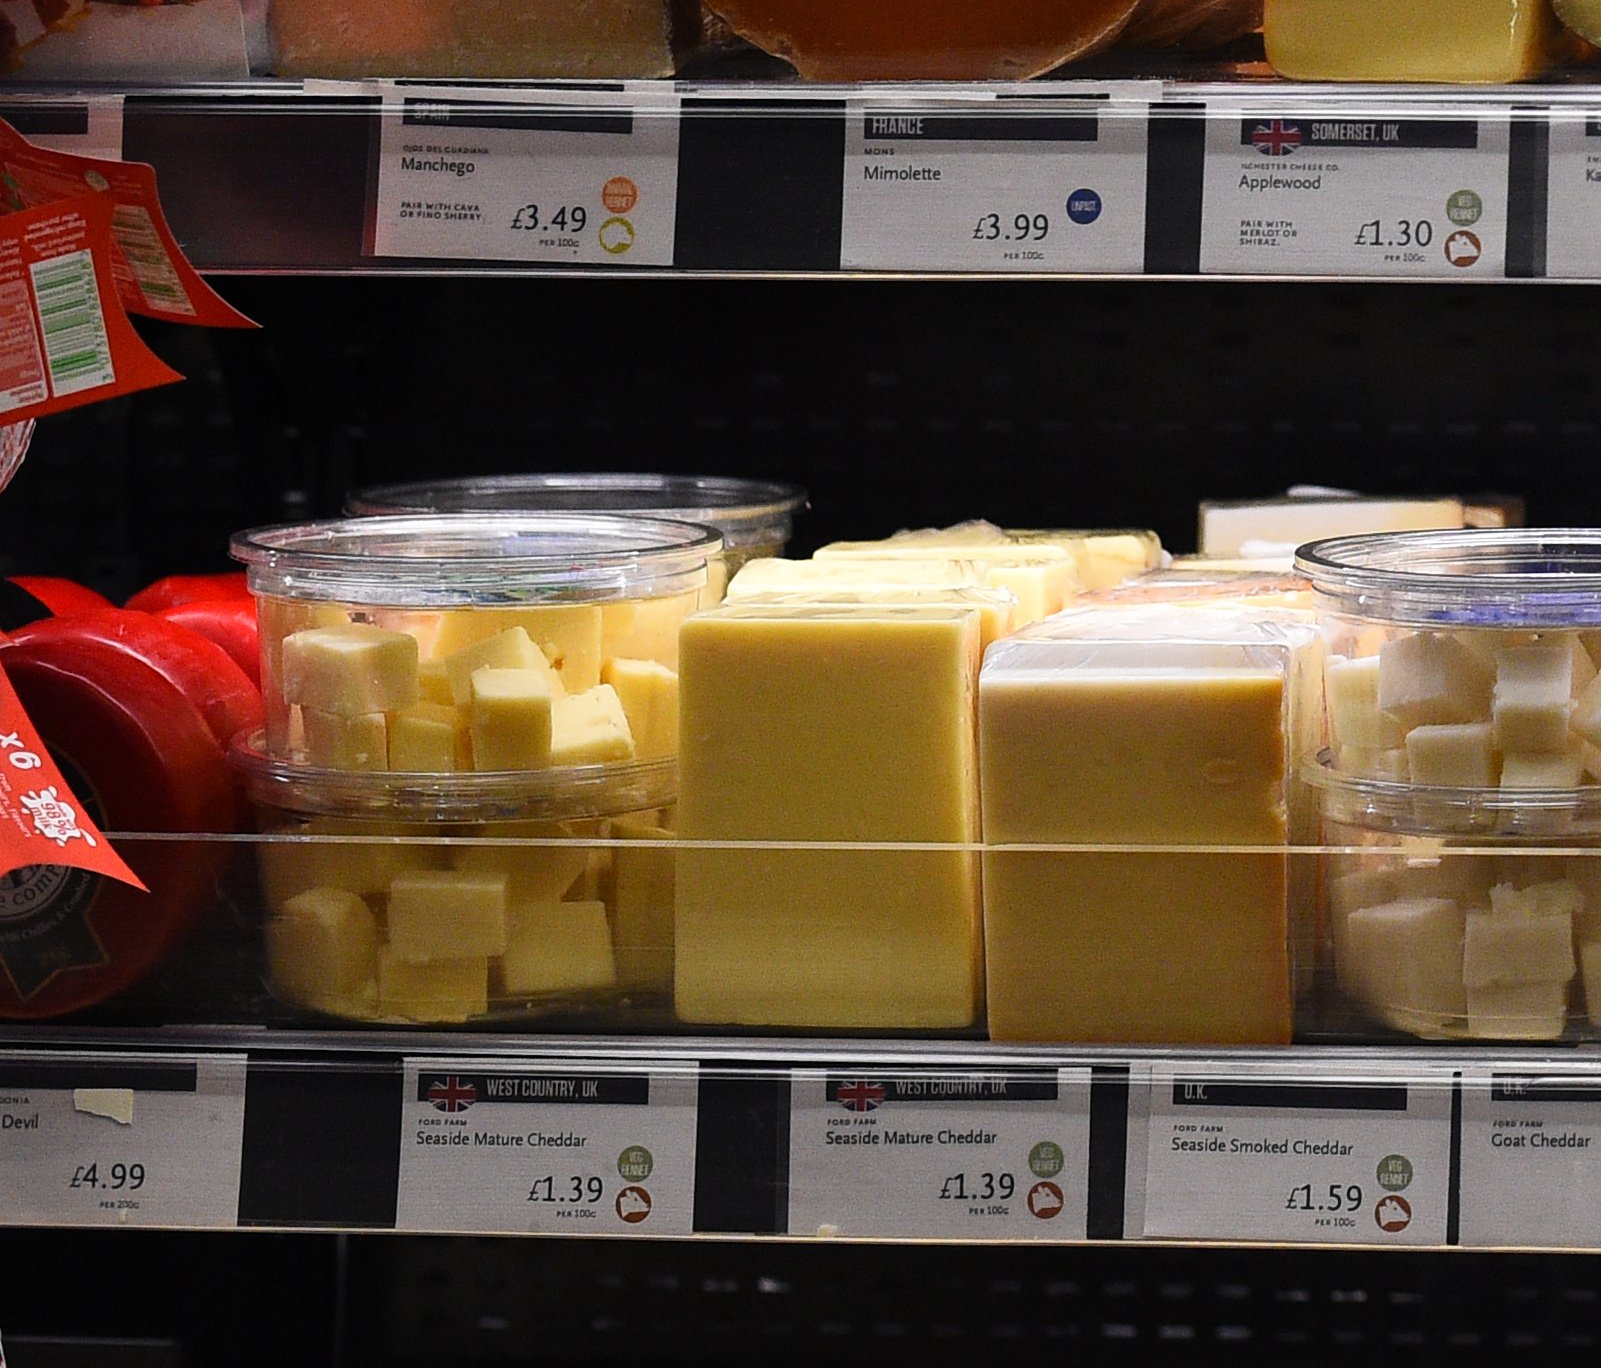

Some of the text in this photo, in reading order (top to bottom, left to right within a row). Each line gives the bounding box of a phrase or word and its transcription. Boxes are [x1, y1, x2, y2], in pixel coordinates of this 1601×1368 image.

[400, 157, 475, 176] Manchego
[863, 165, 942, 181] Mimolette
[1238, 174, 1321, 192] Applewood
[511, 204, 587, 232] £3.49
[973, 213, 1049, 241] £3.99
[1354, 220, 1433, 247] £1.30
[416, 1131, 587, 1148] Seaside Mature Cheddar
[825, 1130, 998, 1146] Seaside Mature Cheddar
[1171, 1137, 1354, 1156] Seaside Smoked Cheddar
[1491, 1133, 1591, 1149] Goat Cheddar
[69, 1163, 146, 1190] £4.99
[939, 1173, 1015, 1200] £1.39
[527, 1175, 603, 1203] £1.39
[1285, 1184, 1363, 1212] £1.59
